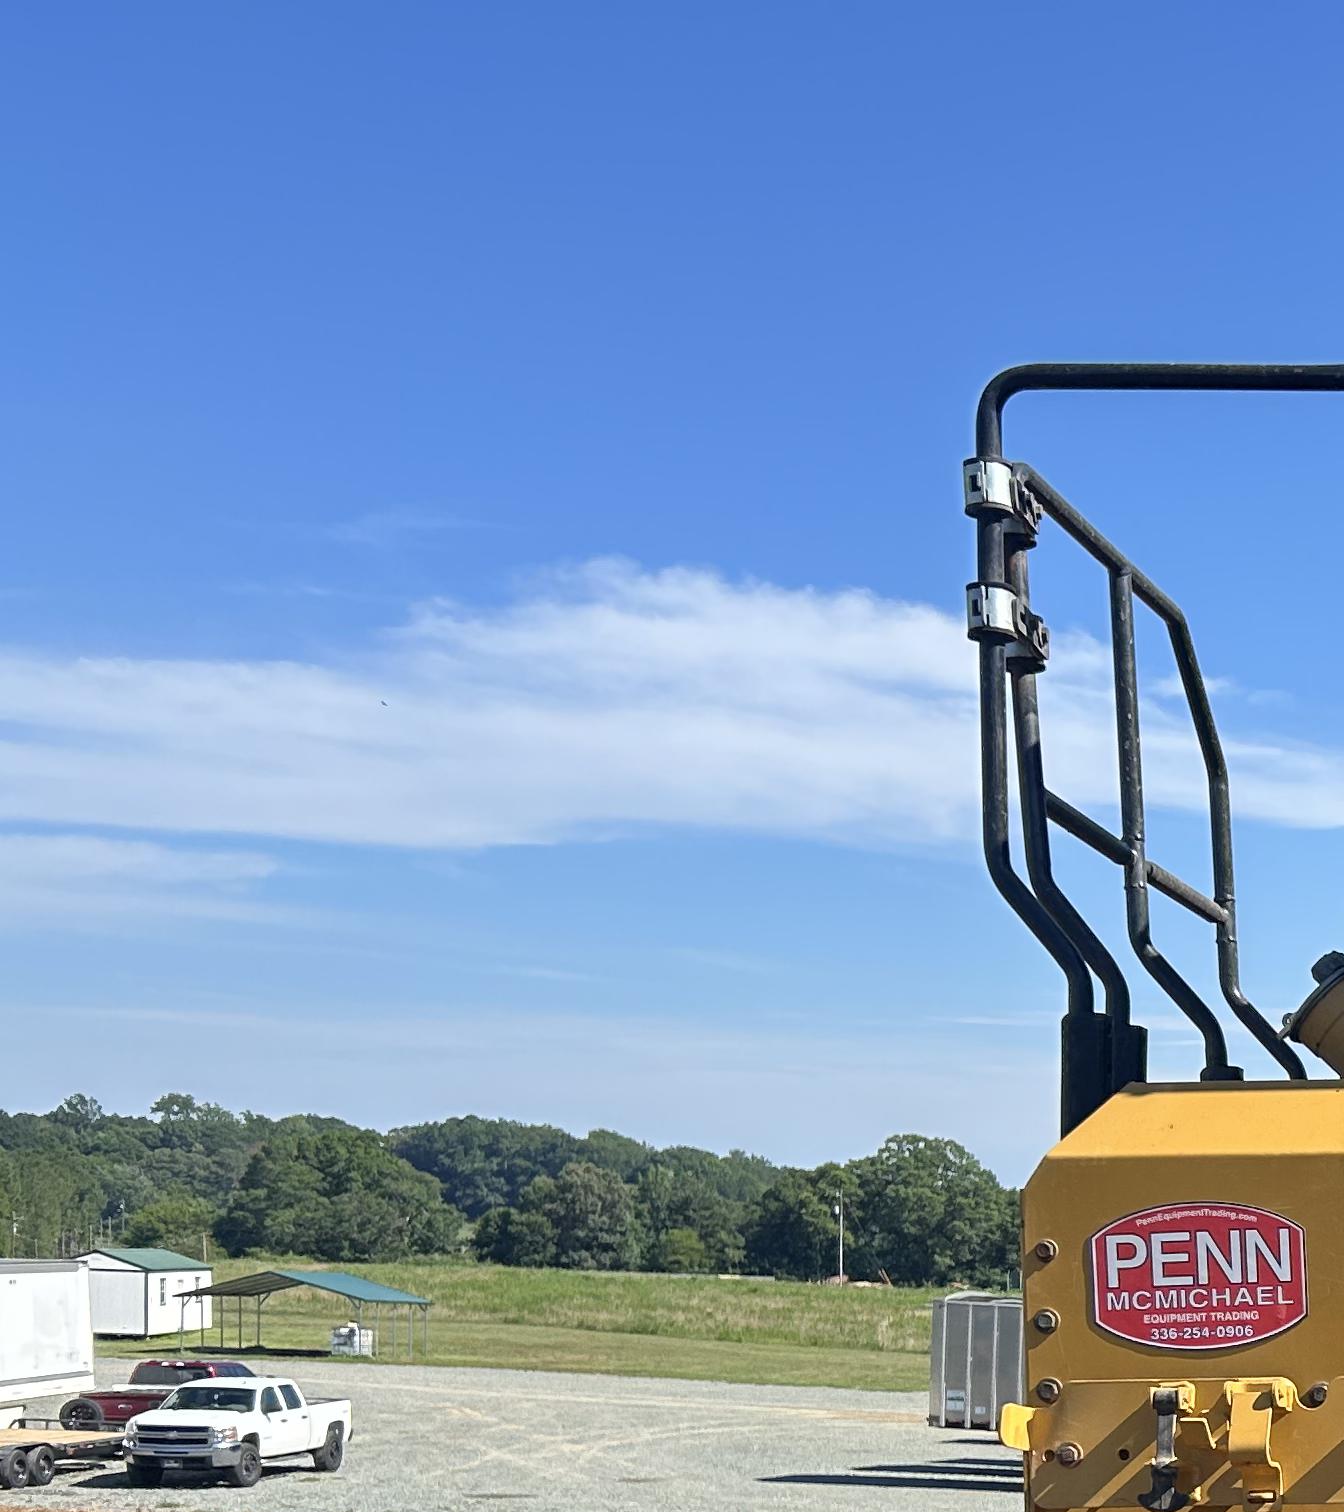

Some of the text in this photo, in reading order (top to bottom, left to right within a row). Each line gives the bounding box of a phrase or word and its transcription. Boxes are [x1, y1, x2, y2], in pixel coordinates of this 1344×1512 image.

[1136, 1208, 1257, 1226] PennEquipmentTrading.com
[1105, 1229, 1292, 1288] PENN
[1107, 1286, 1294, 1311] MCMICHAEL
[1143, 1310, 1259, 1324] EQUIPMENT TRADING
[1150, 1325, 1253, 1340] 336-254-0906
